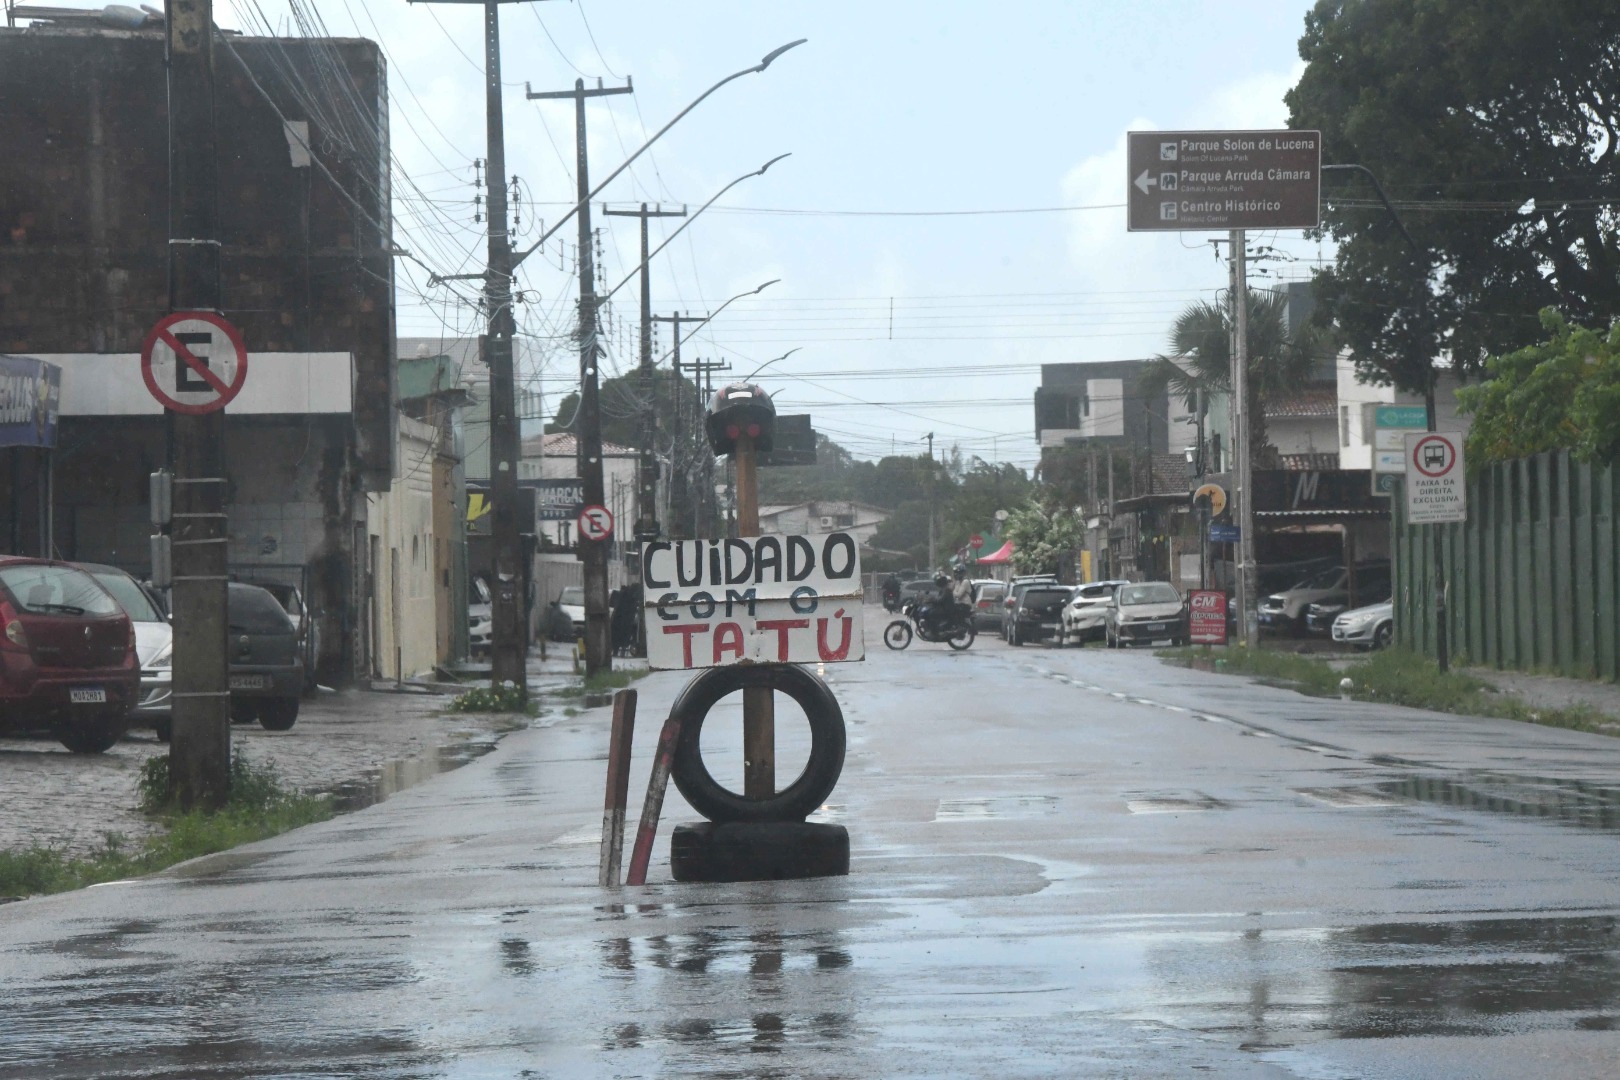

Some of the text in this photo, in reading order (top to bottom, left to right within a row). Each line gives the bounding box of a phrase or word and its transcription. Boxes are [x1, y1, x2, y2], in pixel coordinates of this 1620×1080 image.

[1181, 138, 1314, 153] Parque Solon de Lucena
[1181, 168, 1311, 184] Parque Arruda Câmara
[1229, 184, 1244, 192] Park
[1181, 199, 1281, 212] Centro Histórico
[174, 332, 214, 393] E
[1415, 478, 1455, 487] FAIXA DA
[1419, 487, 1452, 495] DIREITA
[1413, 495, 1459, 504] EXCLUSIVA
[589, 513, 603, 534] E
[656, 585, 819, 621] COM O
[1191, 596, 1216, 607] CM
[662, 607, 853, 668] TATÚ
